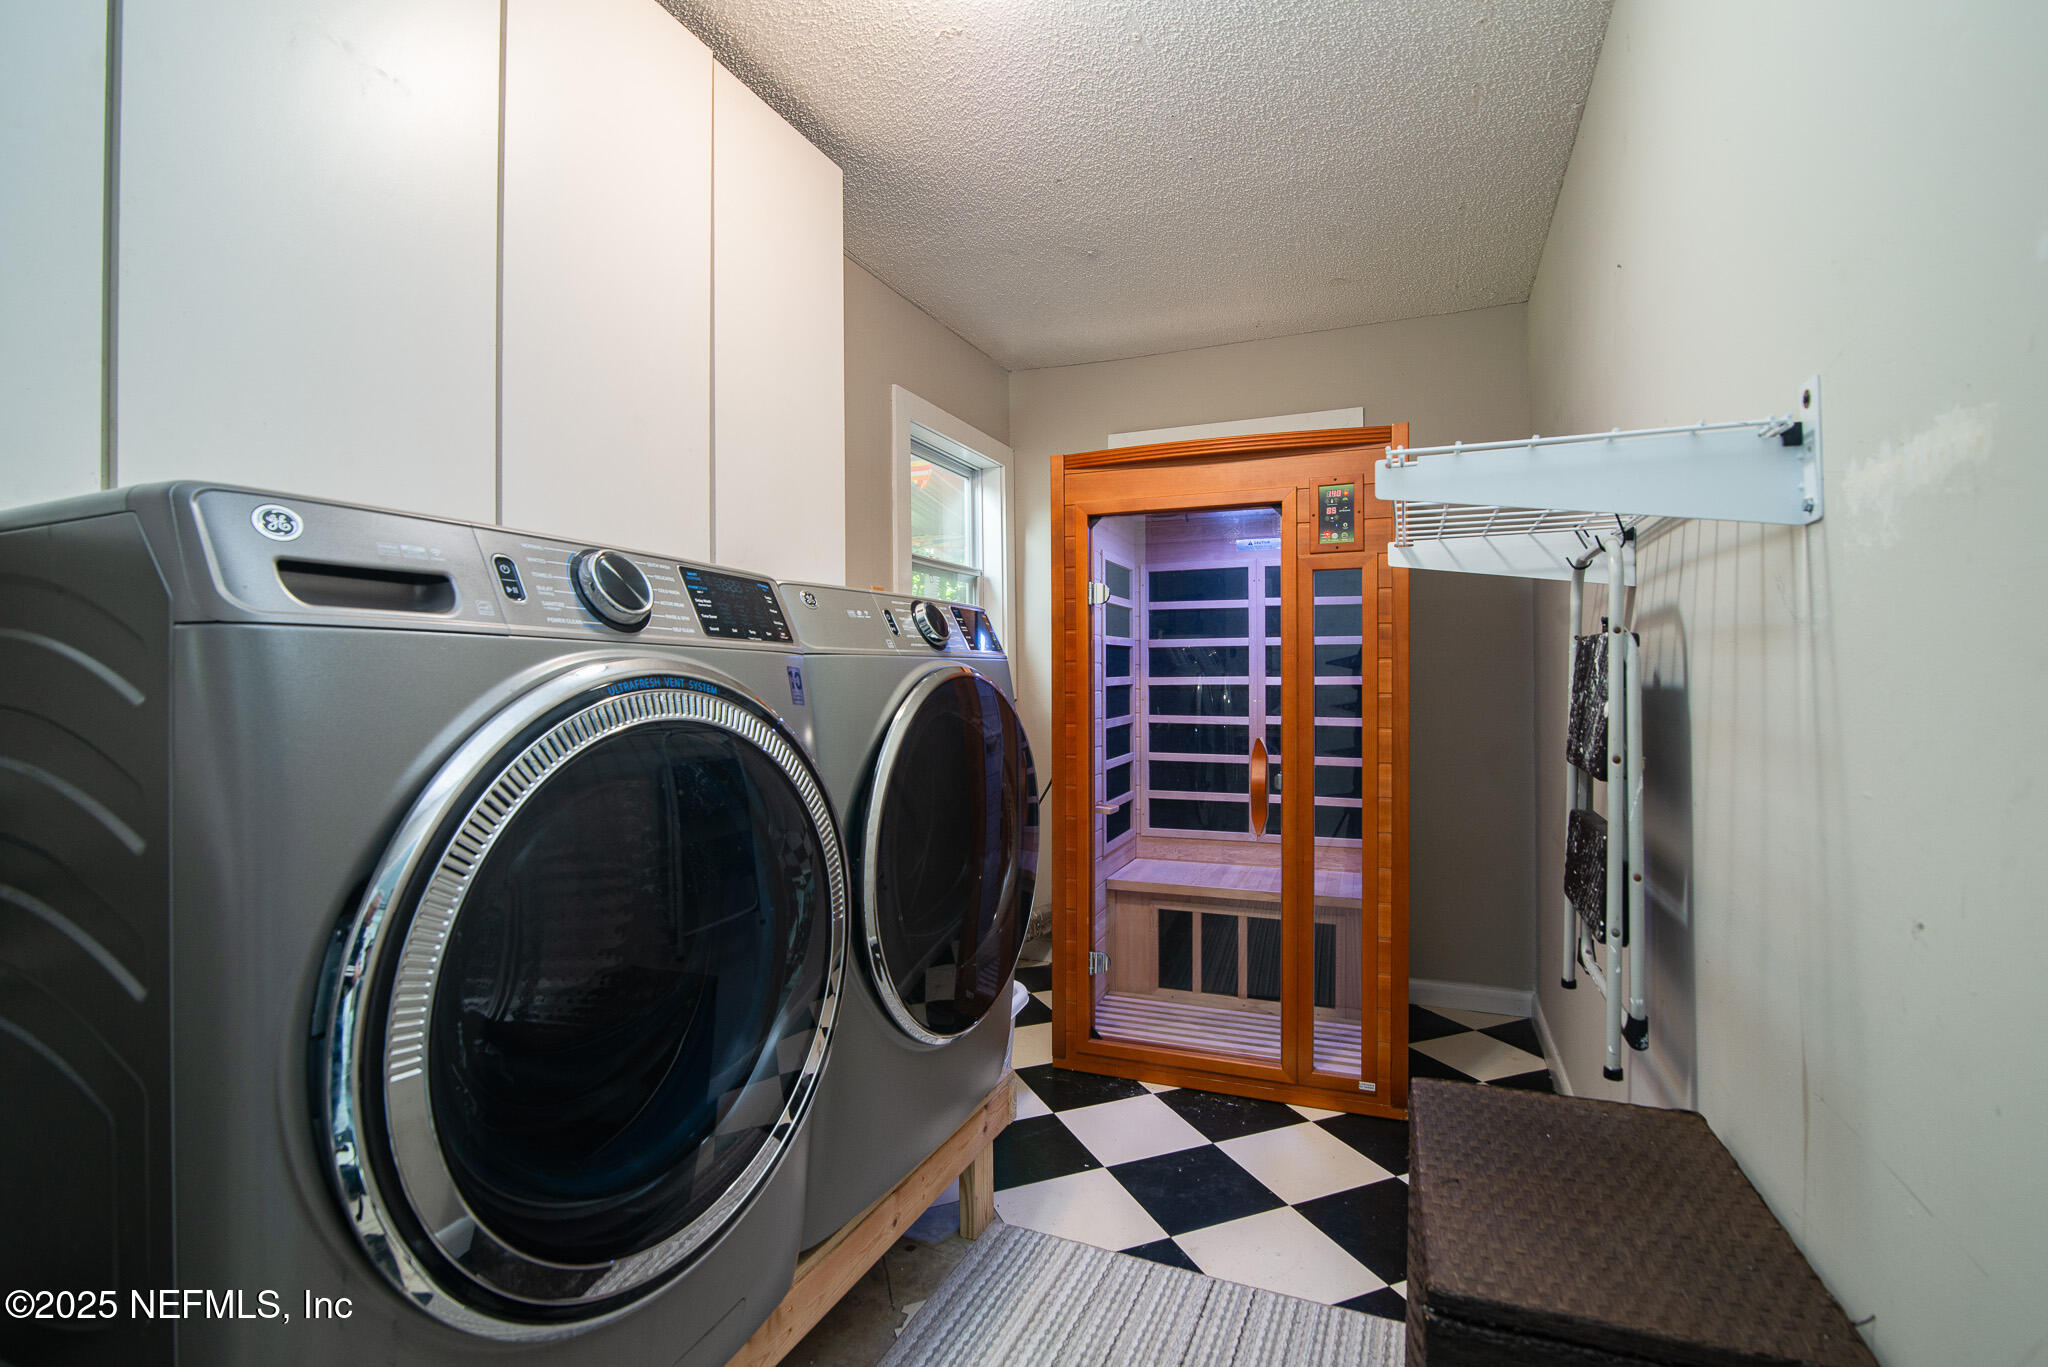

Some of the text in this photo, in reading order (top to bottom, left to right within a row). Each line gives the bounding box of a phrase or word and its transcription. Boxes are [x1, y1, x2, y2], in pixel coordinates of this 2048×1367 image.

[607, 677, 717, 696] ULTRAFRESH VENT SYSTEM
